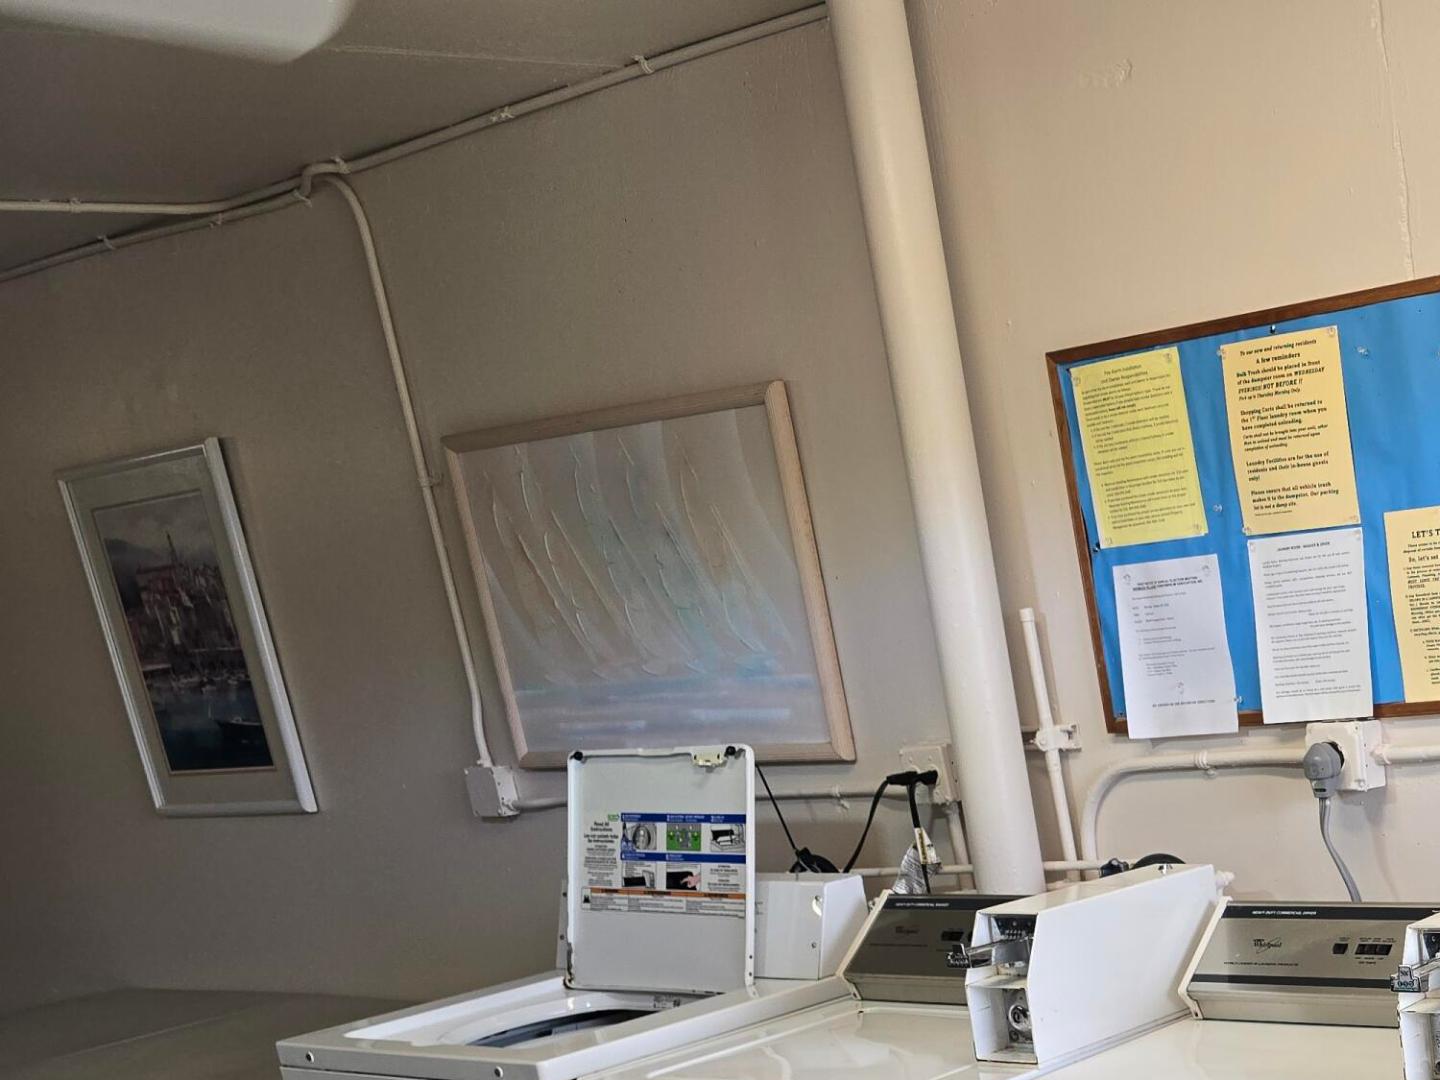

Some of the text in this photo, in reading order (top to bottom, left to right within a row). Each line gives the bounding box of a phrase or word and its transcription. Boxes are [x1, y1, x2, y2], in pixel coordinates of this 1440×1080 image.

[1272, 353, 1300, 362] reminders
[1261, 366, 1276, 374] should
[1284, 362, 1300, 371] placed
[1294, 367, 1325, 376] WEDNESDAY
[1276, 379, 1297, 387] BEFORE
[1295, 400, 1316, 408] returned
[1254, 421, 1277, 429] completed
[1320, 489, 1339, 497] parking
[1412, 530, 1434, 539] LET'S
